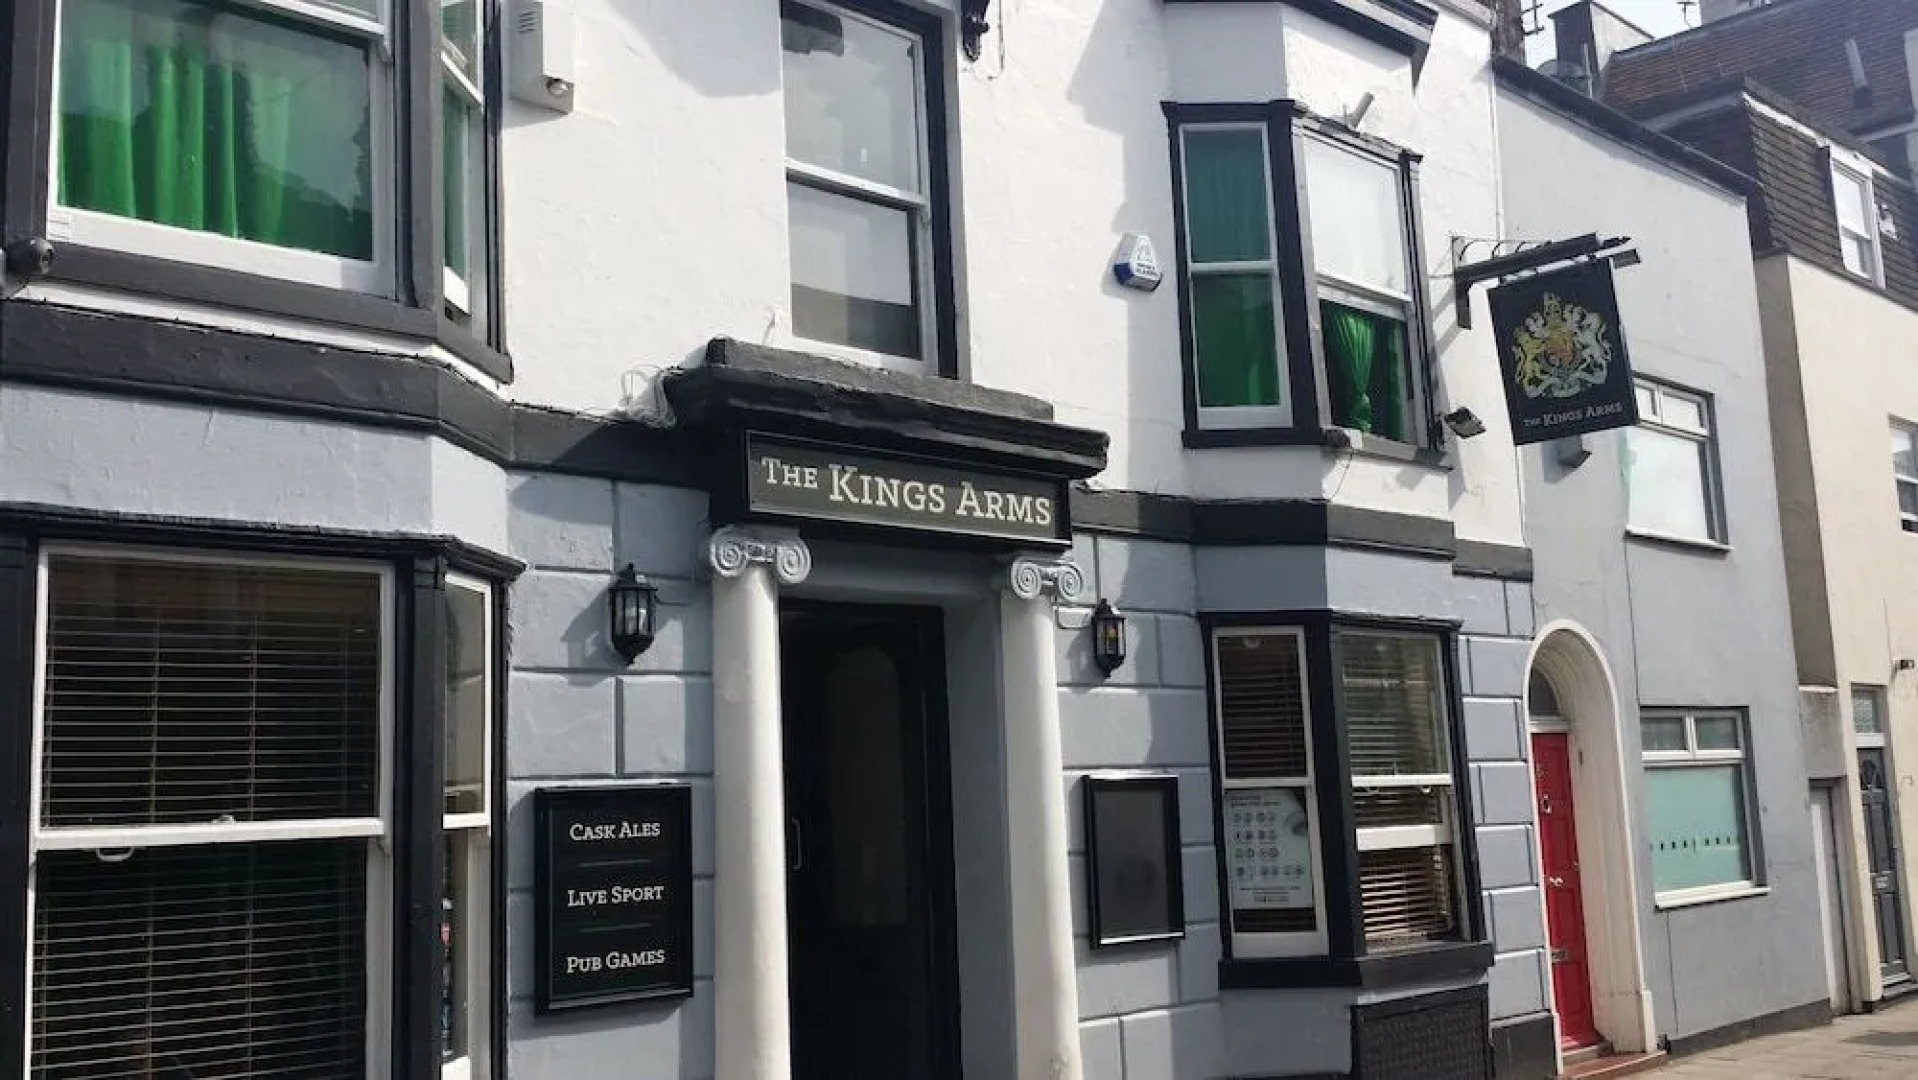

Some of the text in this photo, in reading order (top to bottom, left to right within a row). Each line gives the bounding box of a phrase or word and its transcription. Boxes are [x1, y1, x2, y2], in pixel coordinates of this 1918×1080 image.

[760, 456, 1052, 526] THE KINGS ARMS
[569, 821, 661, 841] CASK ALES
[567, 885, 665, 907] LIVE SPORT
[566, 950, 666, 973] PUB GAMES
